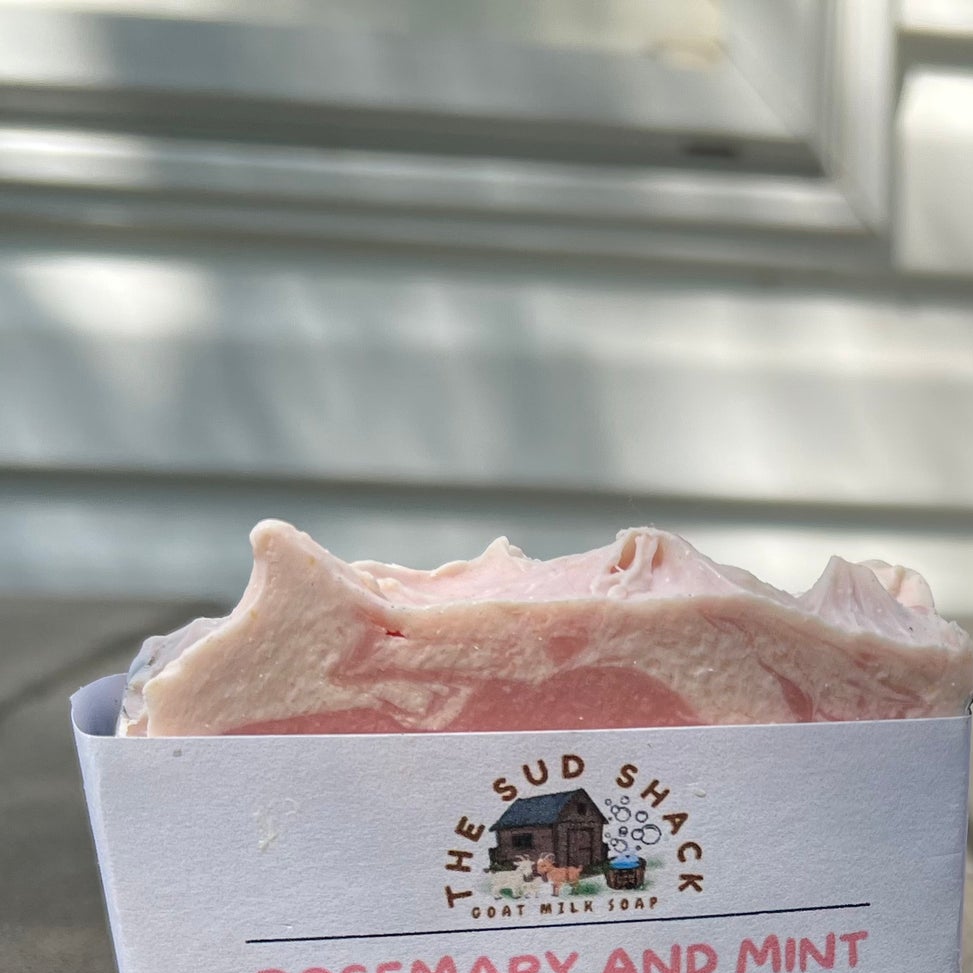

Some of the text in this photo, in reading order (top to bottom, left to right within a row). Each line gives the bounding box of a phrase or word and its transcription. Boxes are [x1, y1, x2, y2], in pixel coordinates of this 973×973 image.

[445, 754, 704, 909] THE SUD SHACK
[471, 896, 659, 919] GOAT MILK SOAP
